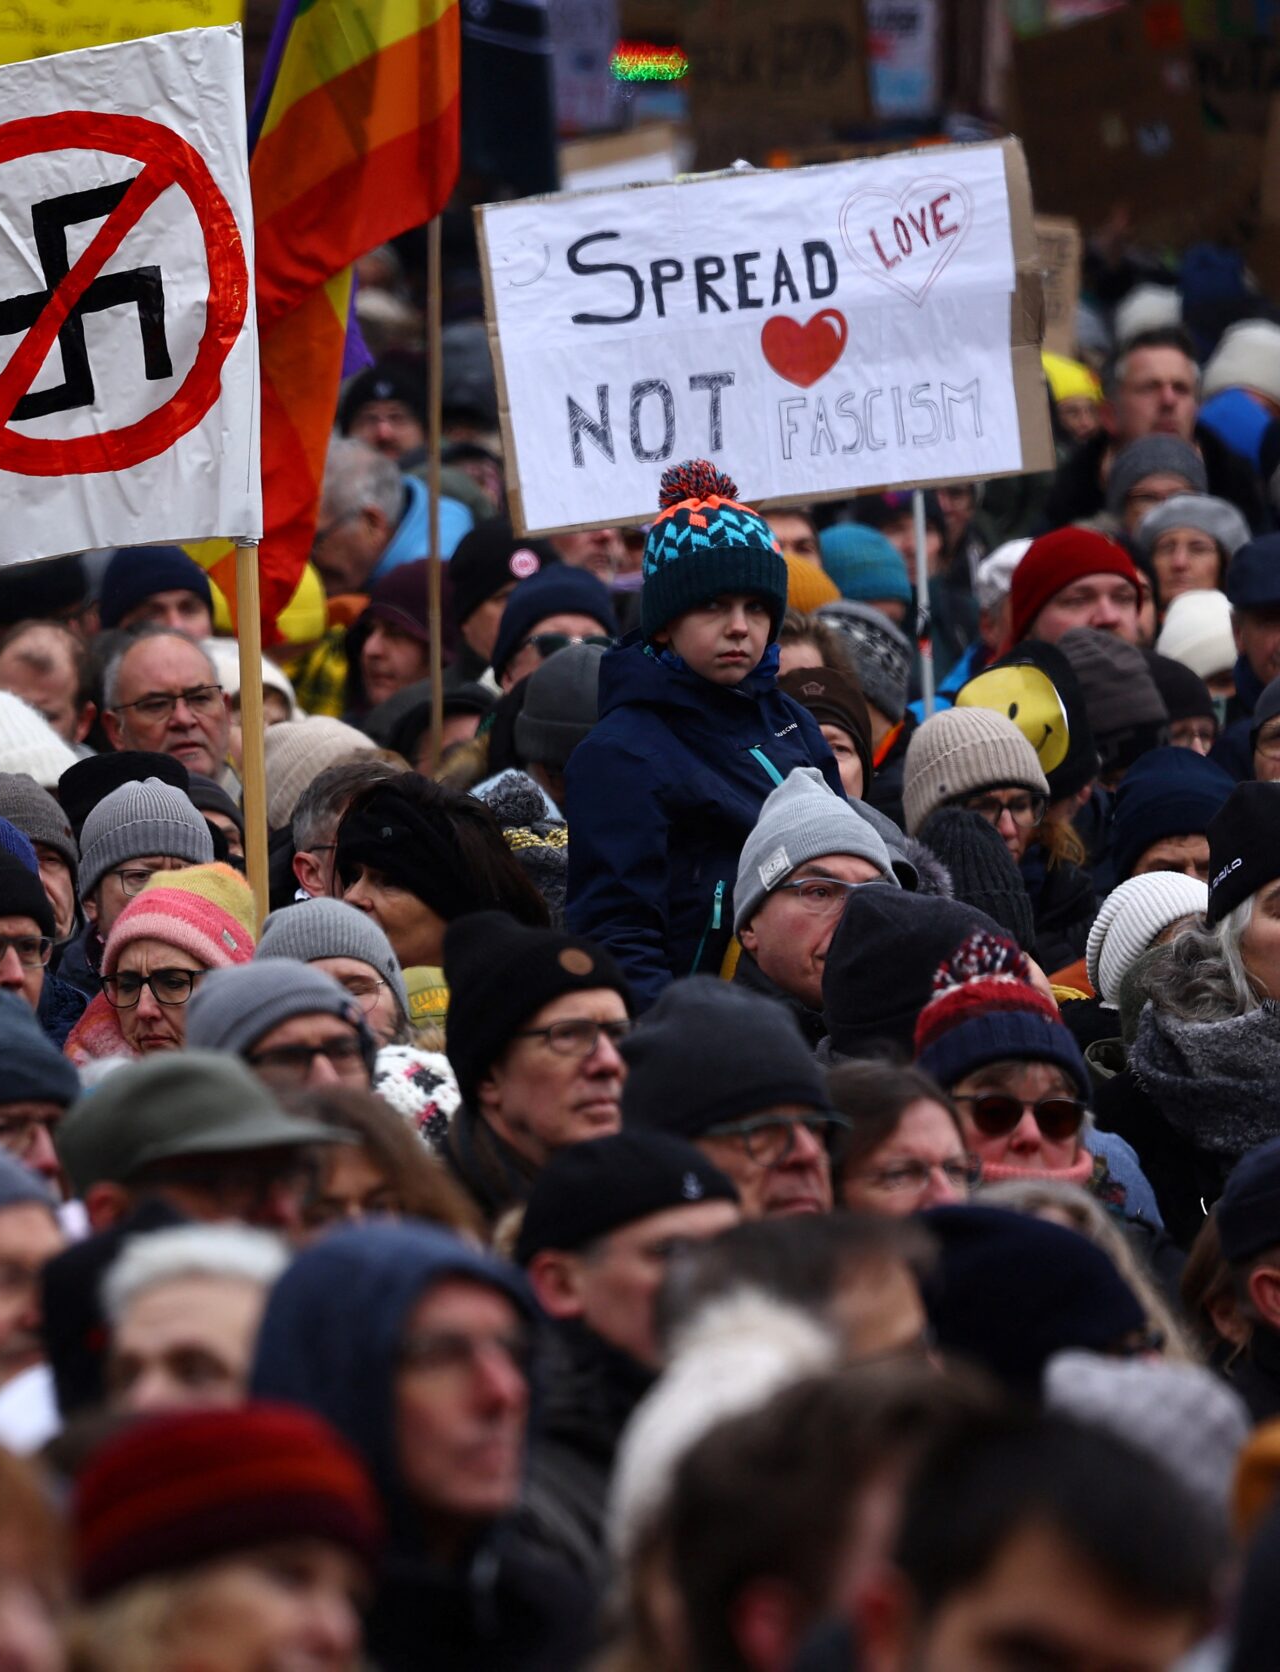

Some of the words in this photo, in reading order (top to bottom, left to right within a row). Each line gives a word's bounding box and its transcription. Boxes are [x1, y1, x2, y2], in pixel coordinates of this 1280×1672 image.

[566, 231, 838, 325] SPREAD
[868, 192, 961, 270] LOVE
[566, 371, 735, 468] NOT
[778, 377, 984, 461] FASCISM
